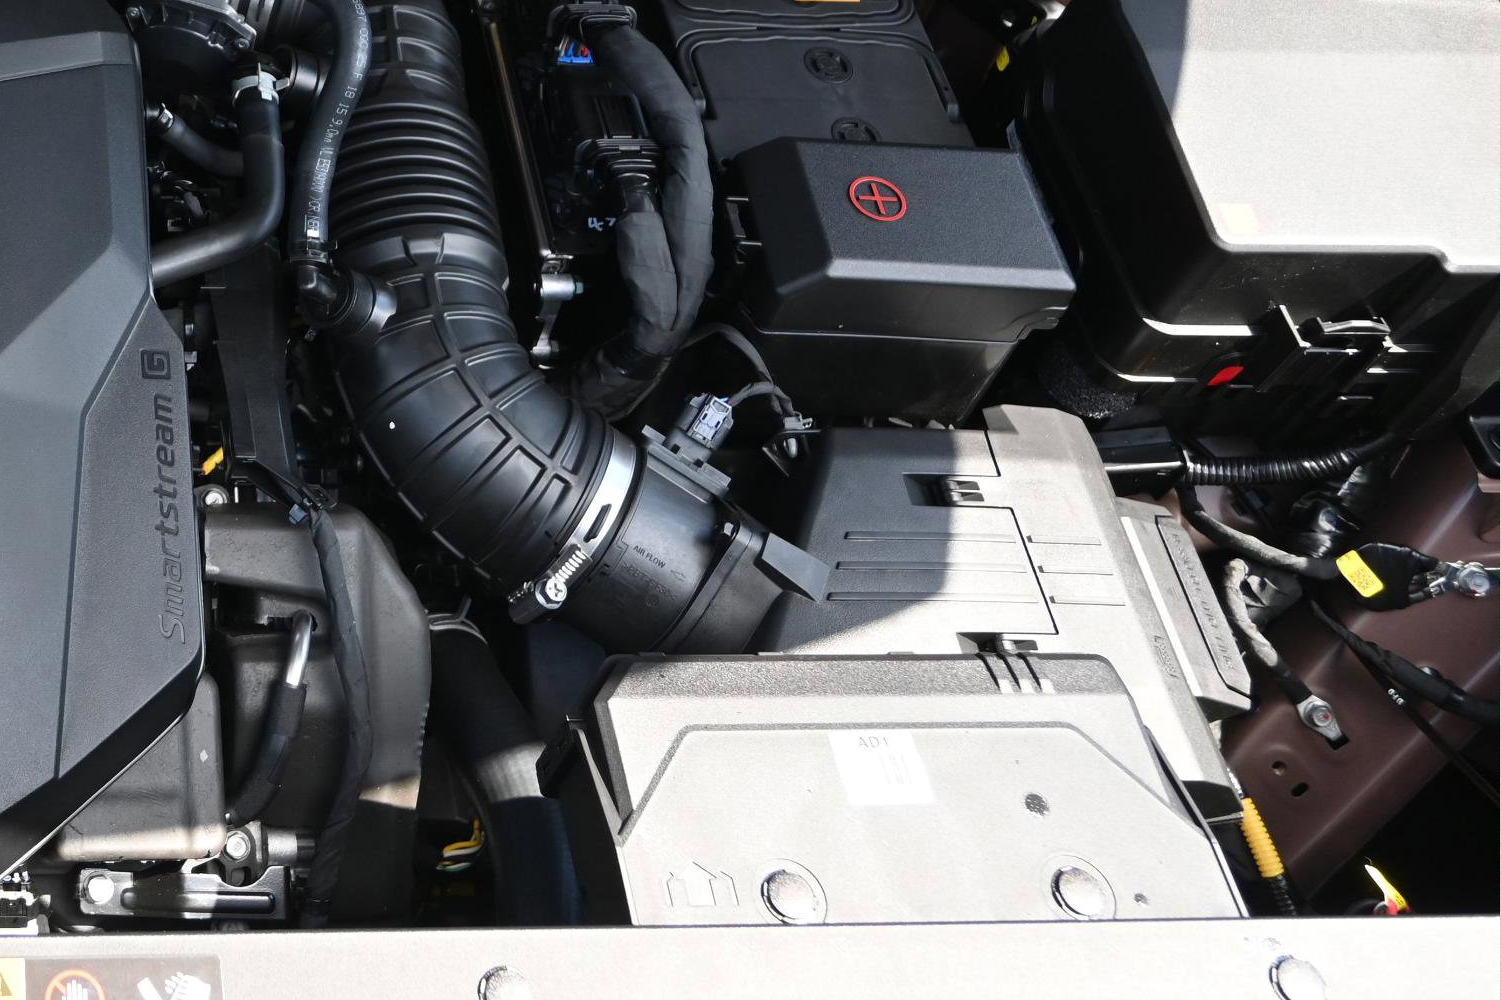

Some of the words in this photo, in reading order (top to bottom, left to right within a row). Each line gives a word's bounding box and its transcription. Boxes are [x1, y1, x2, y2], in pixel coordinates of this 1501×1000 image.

[153, 393, 186, 645] Smartstream
[633, 545, 646, 557] AIR
[646, 552, 666, 568] FLOW
